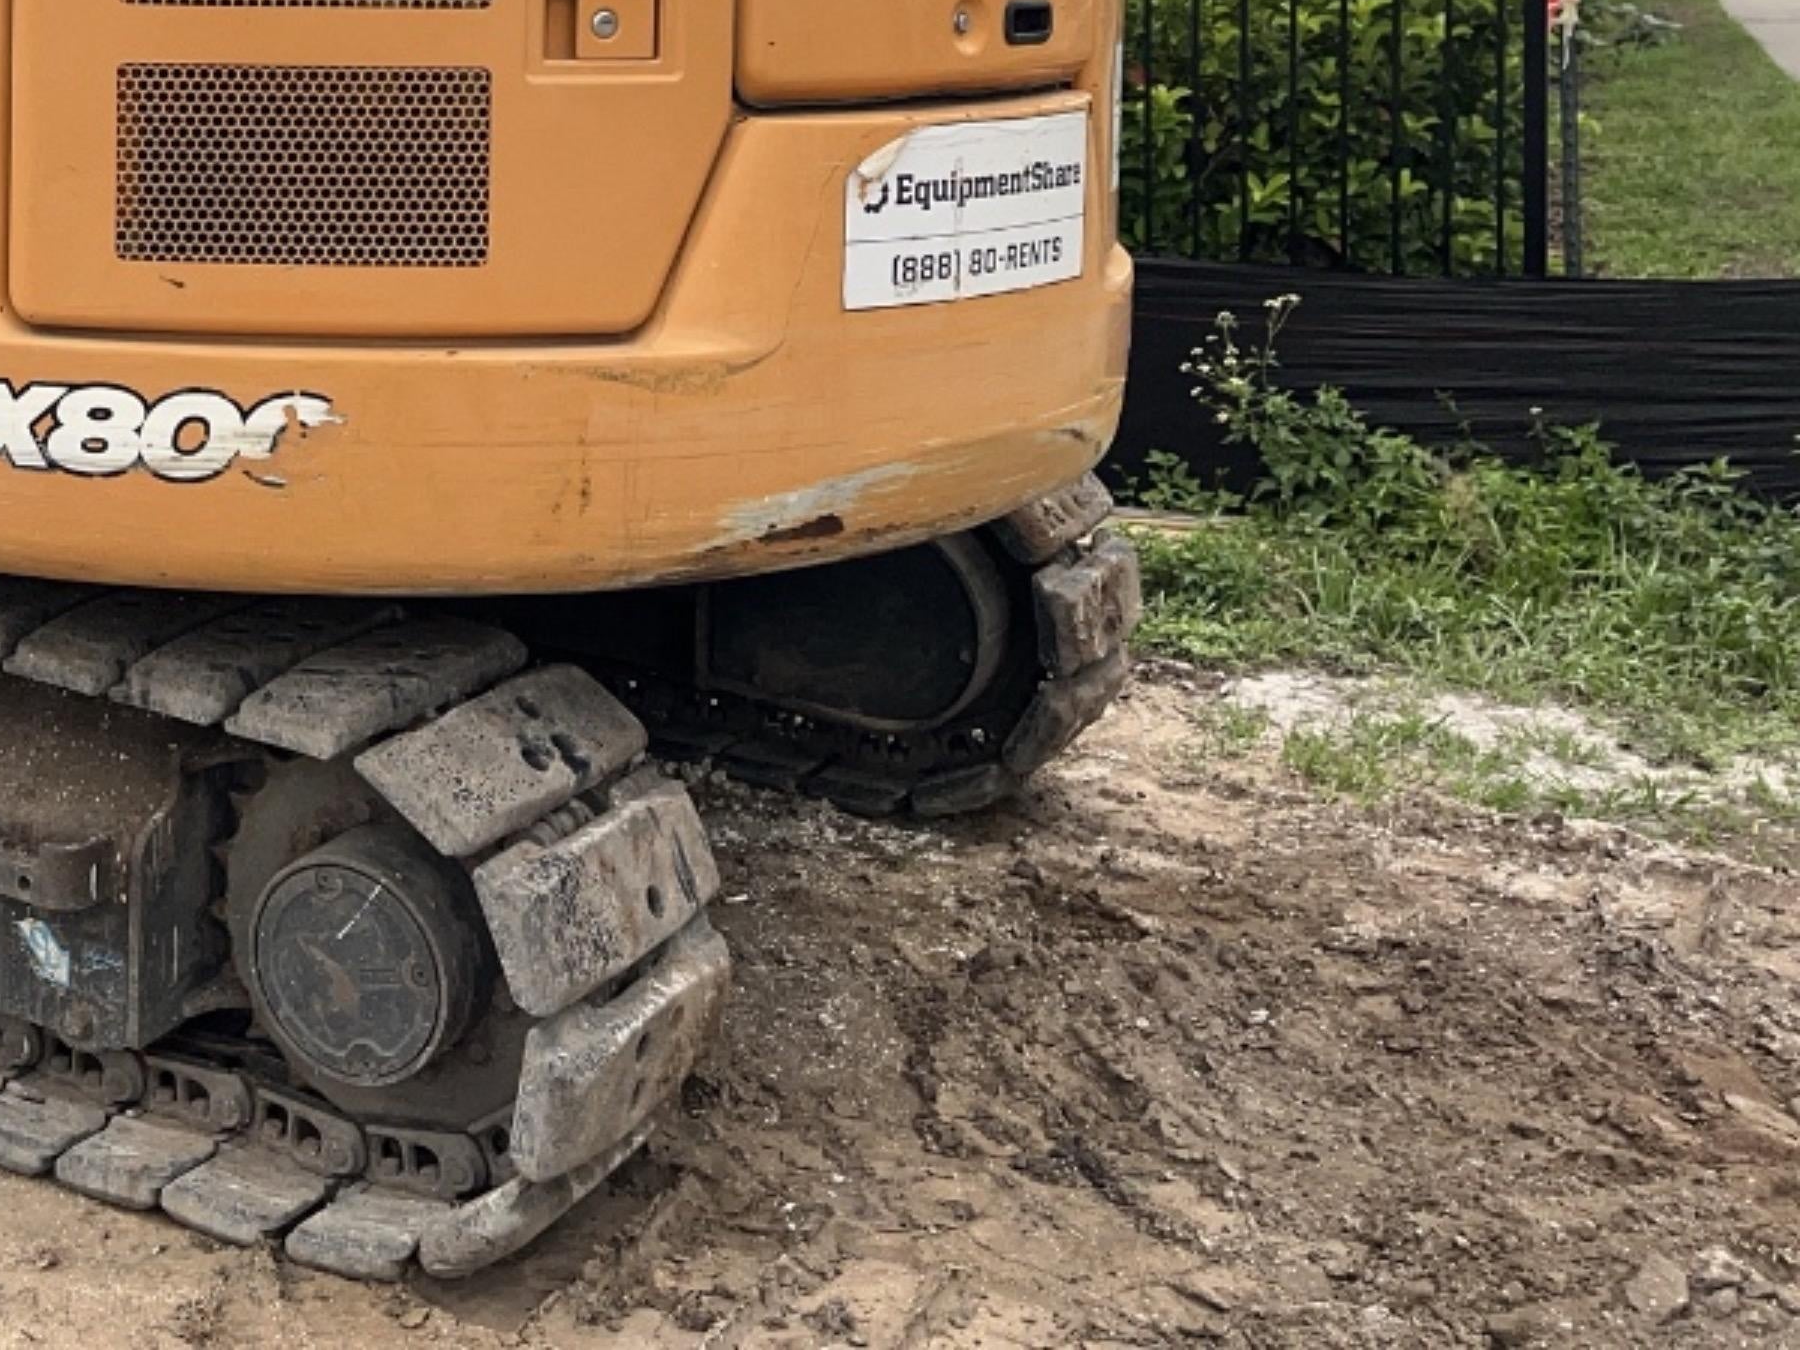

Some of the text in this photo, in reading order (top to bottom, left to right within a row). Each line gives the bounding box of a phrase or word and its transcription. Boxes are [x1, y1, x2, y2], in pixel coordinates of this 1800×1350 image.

[896, 161, 1081, 210] EquipmentShare
[892, 237, 1063, 286] (888) 80-RENTS
